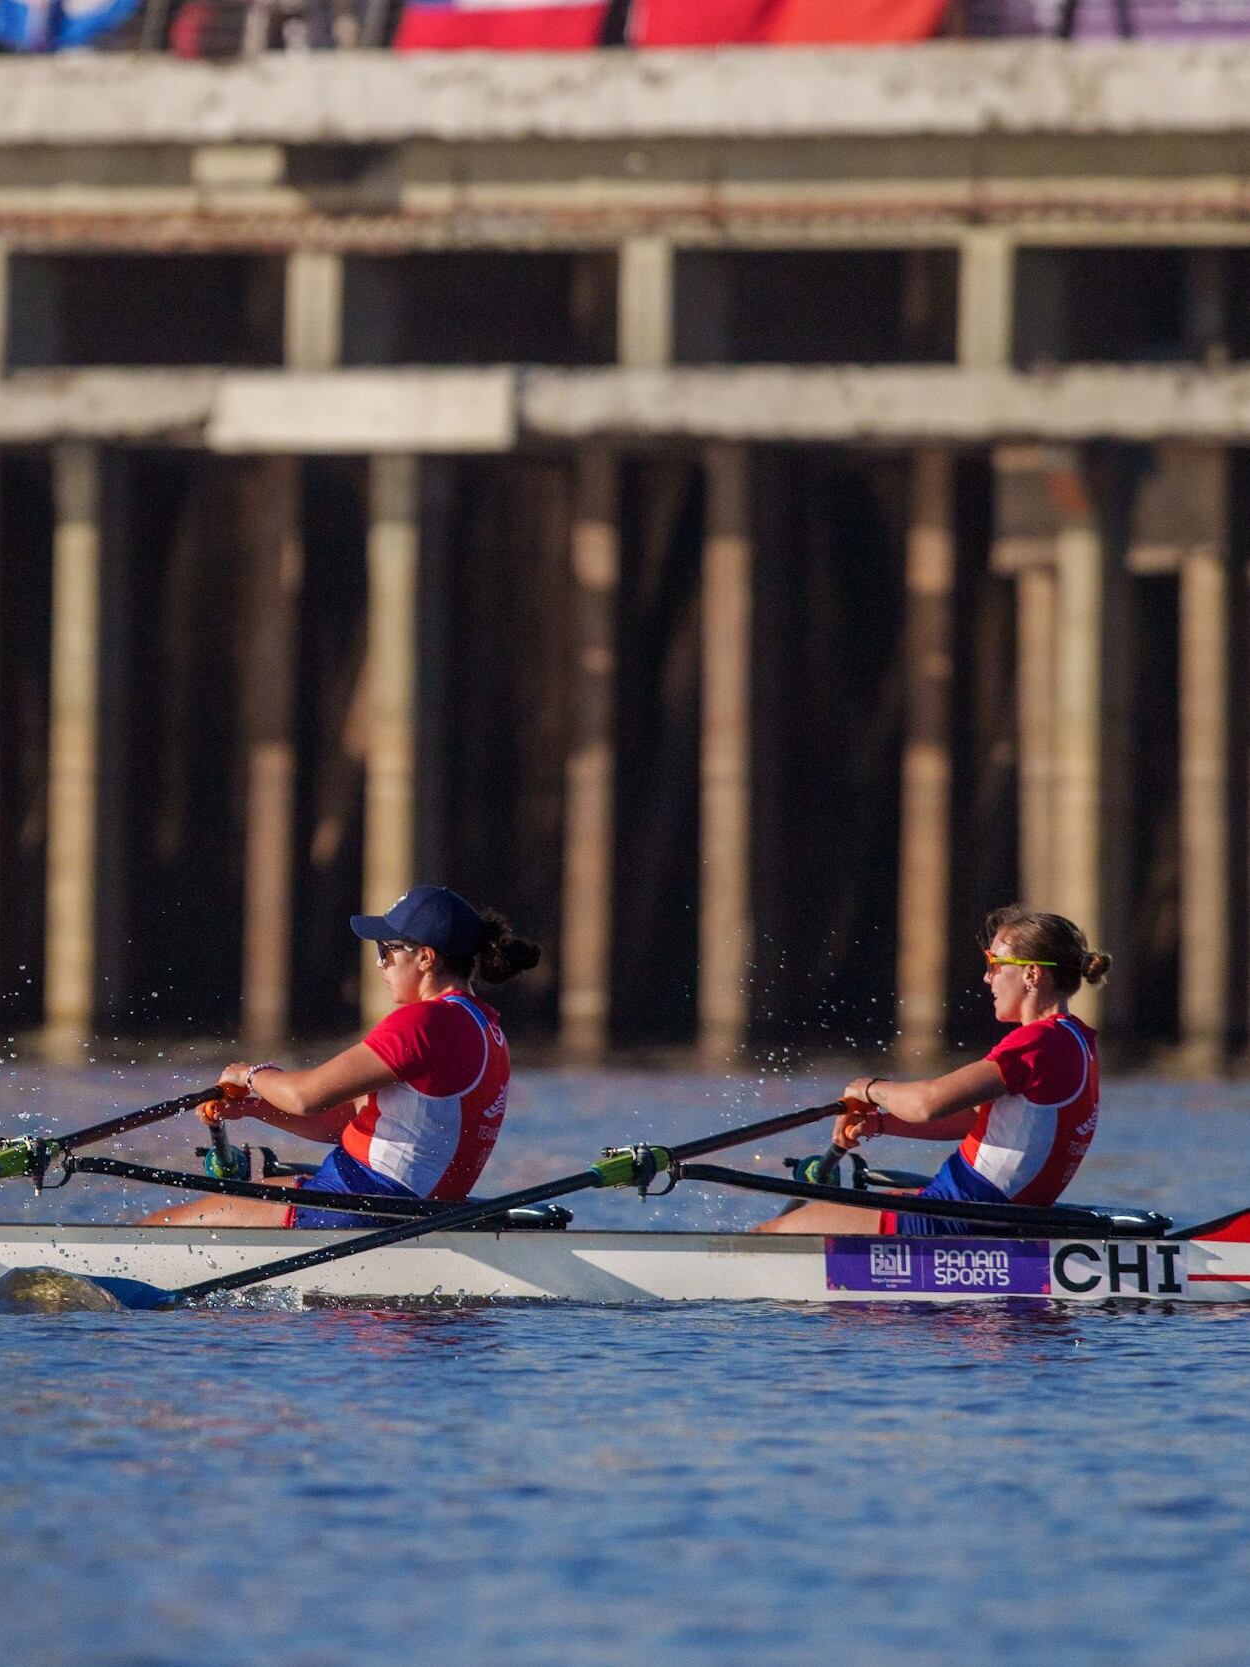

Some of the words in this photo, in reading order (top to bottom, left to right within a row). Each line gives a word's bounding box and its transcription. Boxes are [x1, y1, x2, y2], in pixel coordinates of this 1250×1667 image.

[934, 1248, 1009, 1269] PANAM
[1053, 1243, 1182, 1293] CHI
[934, 1267, 1011, 1287] SPORTS
